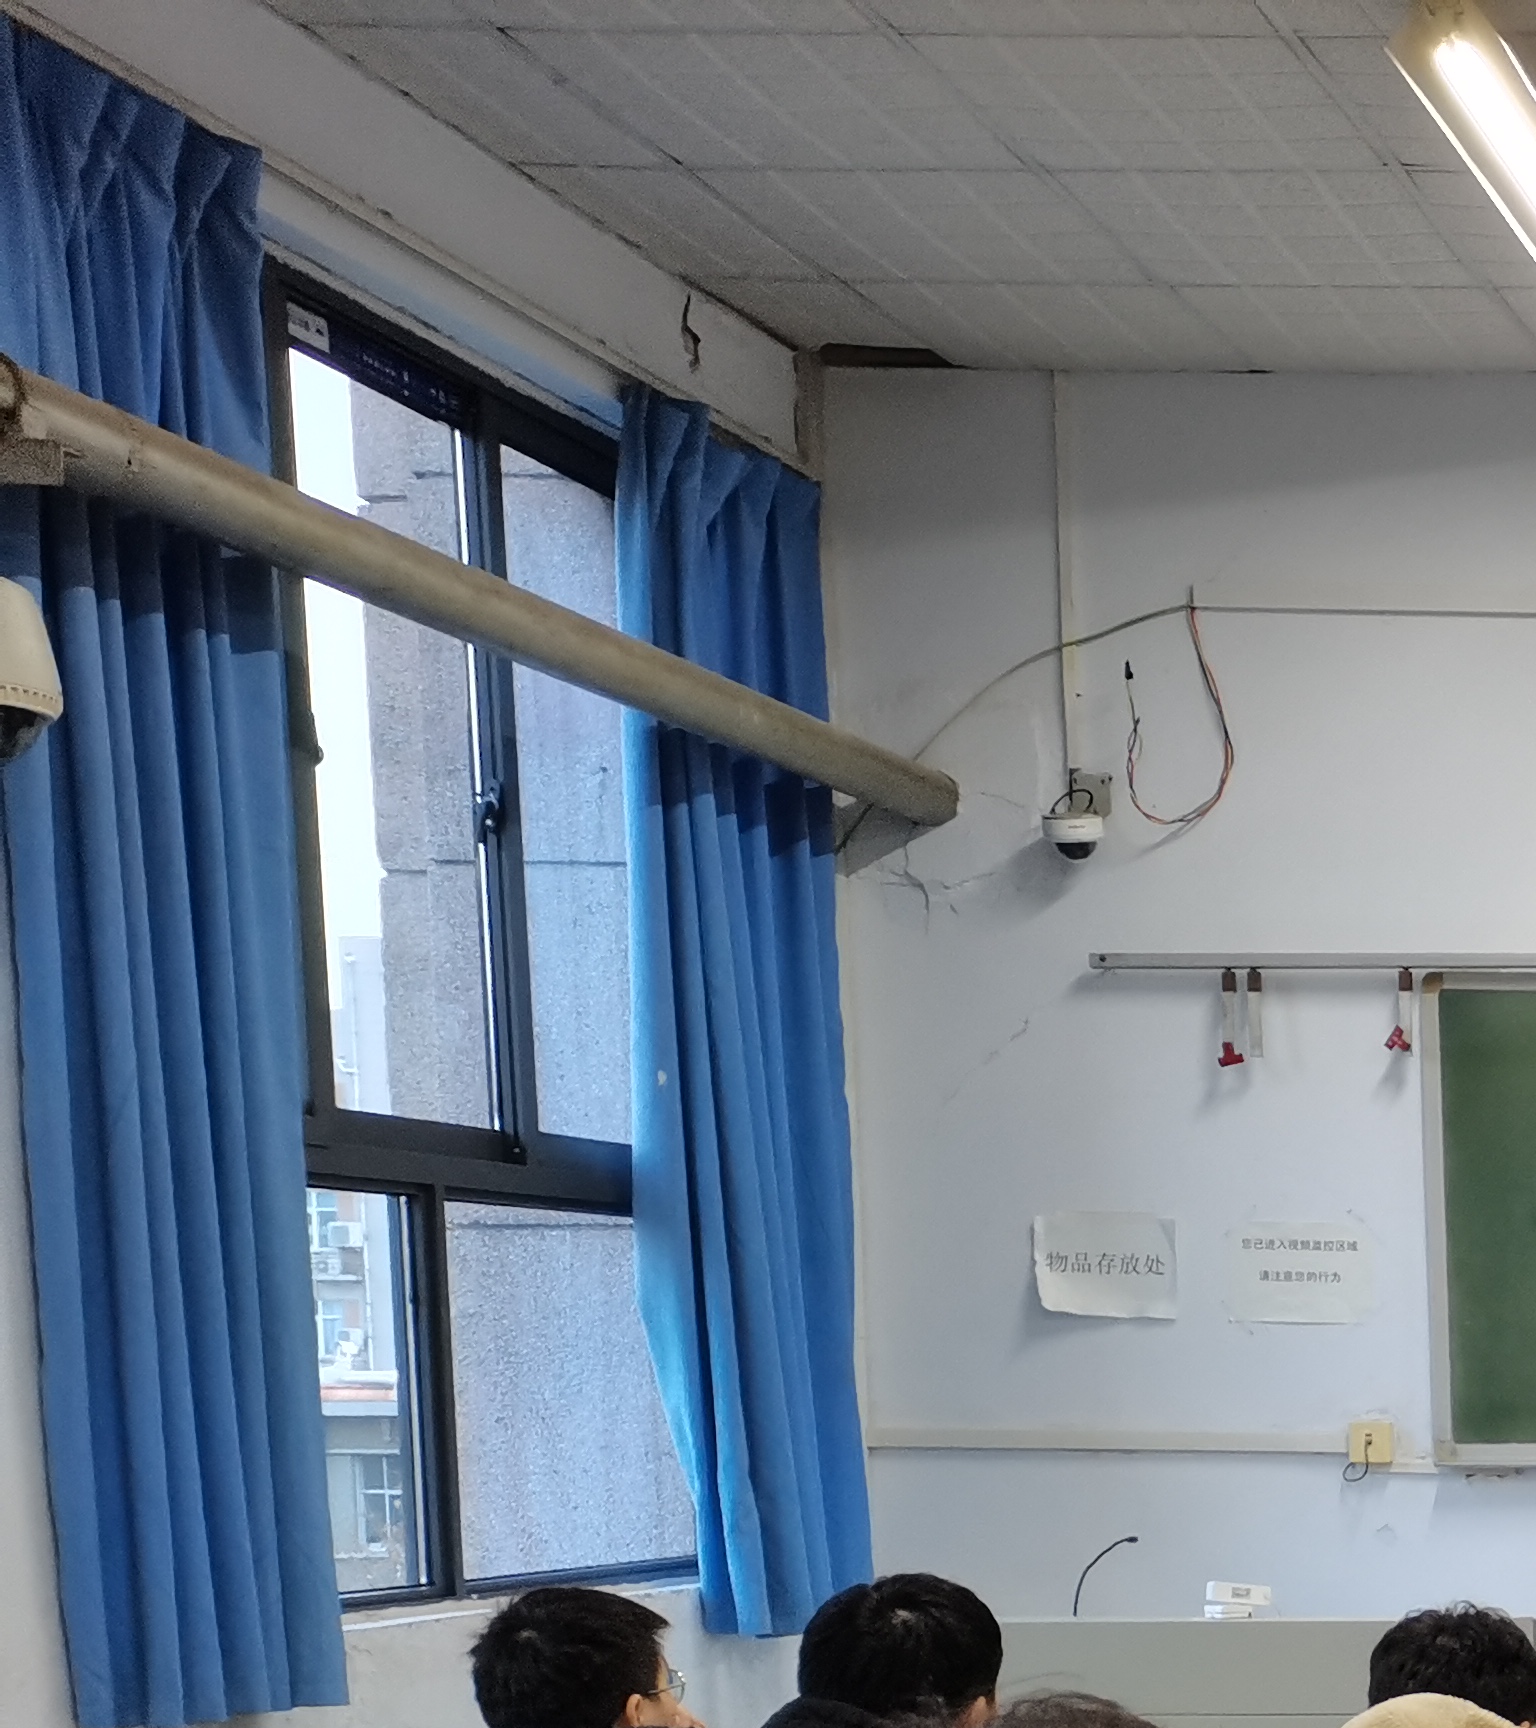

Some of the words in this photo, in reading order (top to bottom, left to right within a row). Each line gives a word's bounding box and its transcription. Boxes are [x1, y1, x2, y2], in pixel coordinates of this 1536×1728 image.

[1045, 1252, 1166, 1277] 物品存放处
[1259, 1269, 1342, 1283] 请注意您的行为
